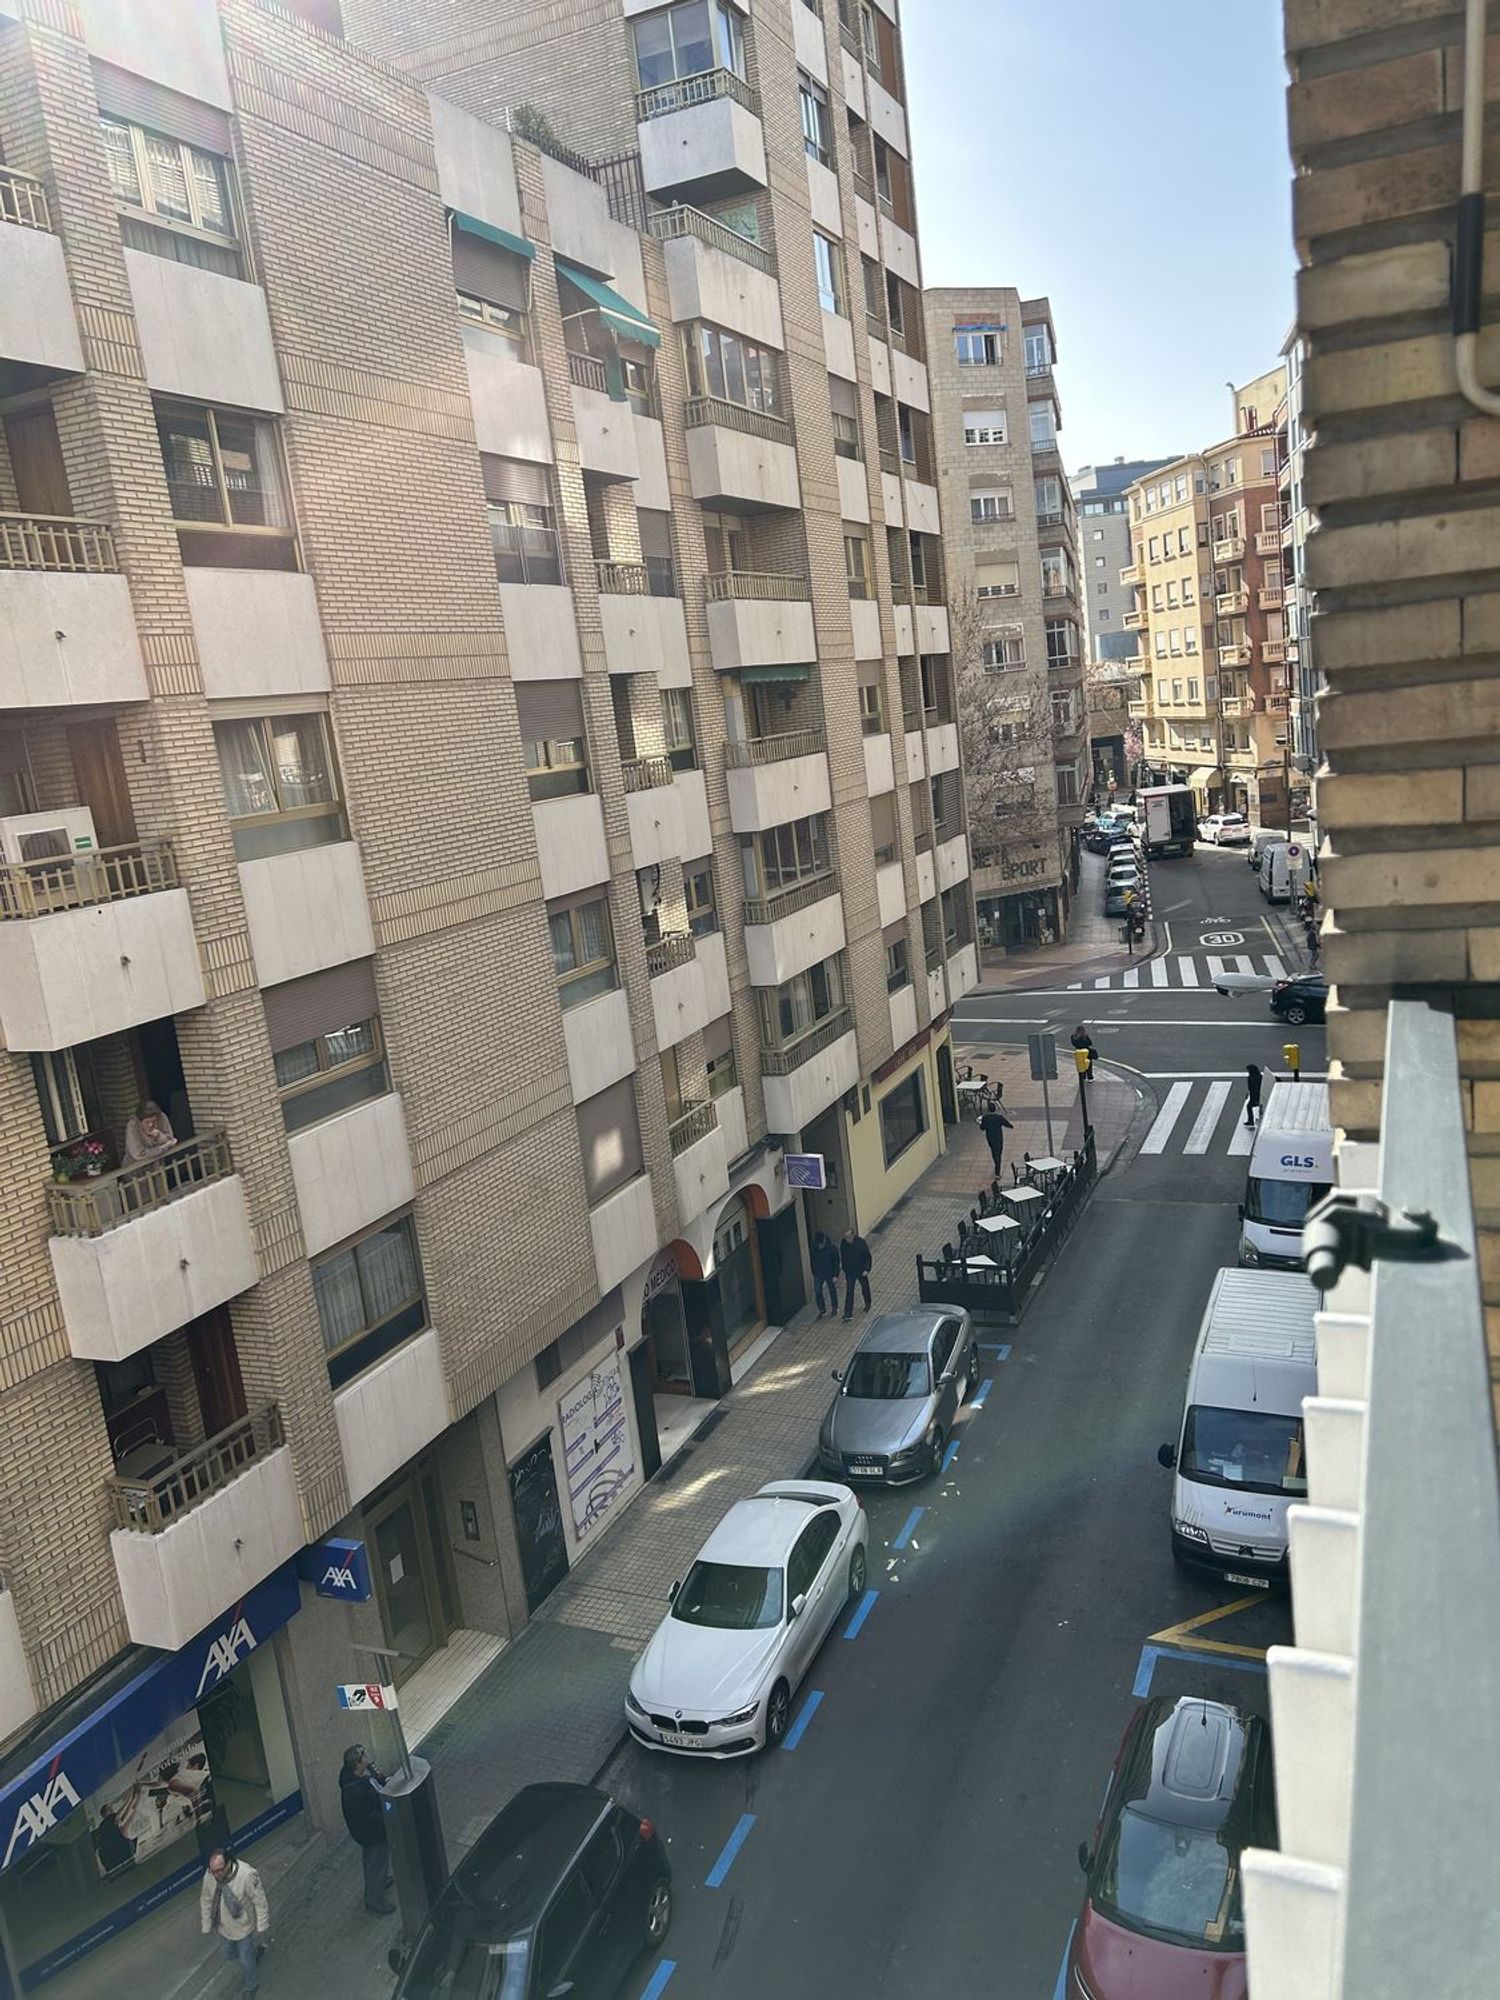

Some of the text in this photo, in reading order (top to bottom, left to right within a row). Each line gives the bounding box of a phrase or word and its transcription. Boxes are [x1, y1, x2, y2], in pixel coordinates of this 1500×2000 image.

[1001, 857, 1047, 881] SPORT
[1210, 934, 1235, 944] 30
[321, 1566, 357, 1590] AXA
[195, 1617, 257, 1699] AXA
[1, 1771, 81, 1870] AXA
